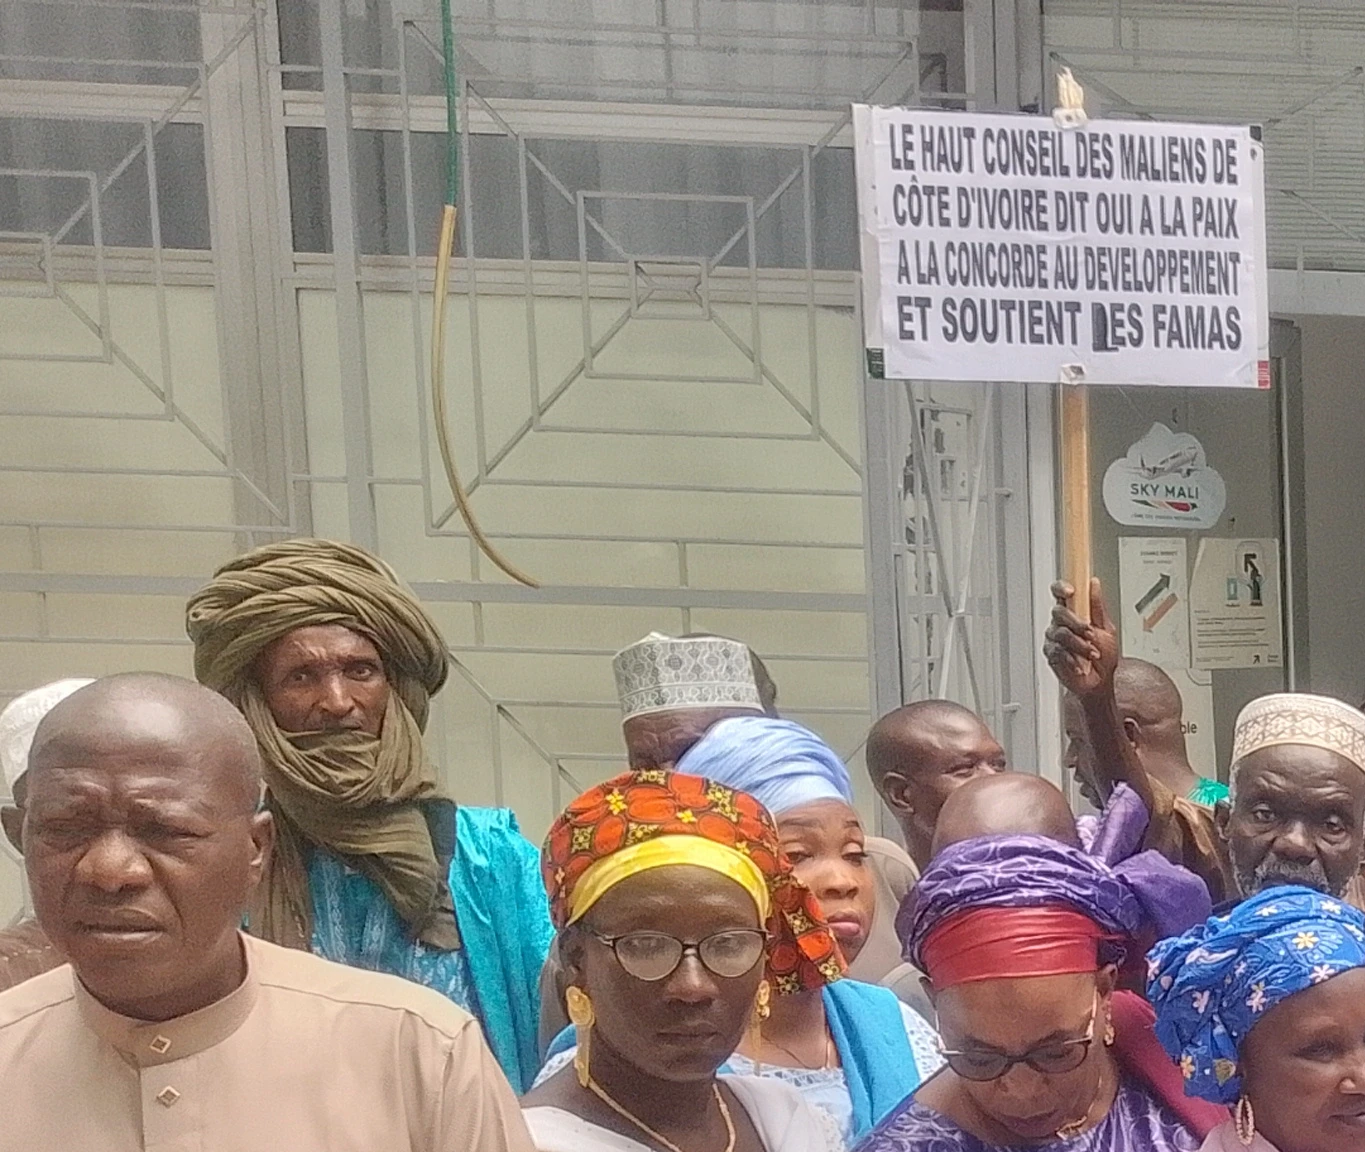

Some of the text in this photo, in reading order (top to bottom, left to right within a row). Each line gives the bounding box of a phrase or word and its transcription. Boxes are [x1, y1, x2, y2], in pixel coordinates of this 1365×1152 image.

[890, 124, 1237, 185] LE HAUT CONSEIL DES MALIENS DE
[893, 175, 1239, 238] CÔTE D'IVOIRE DIT OUI A LA PAIX
[898, 240, 1240, 295] A LA CONCORDE AU DEVELOPPEMENT
[897, 296, 932, 341] ET
[942, 297, 1081, 345] SOUTIENT
[1153, 304, 1241, 350] FAMAS
[1130, 483, 1199, 499] SKY MALI
